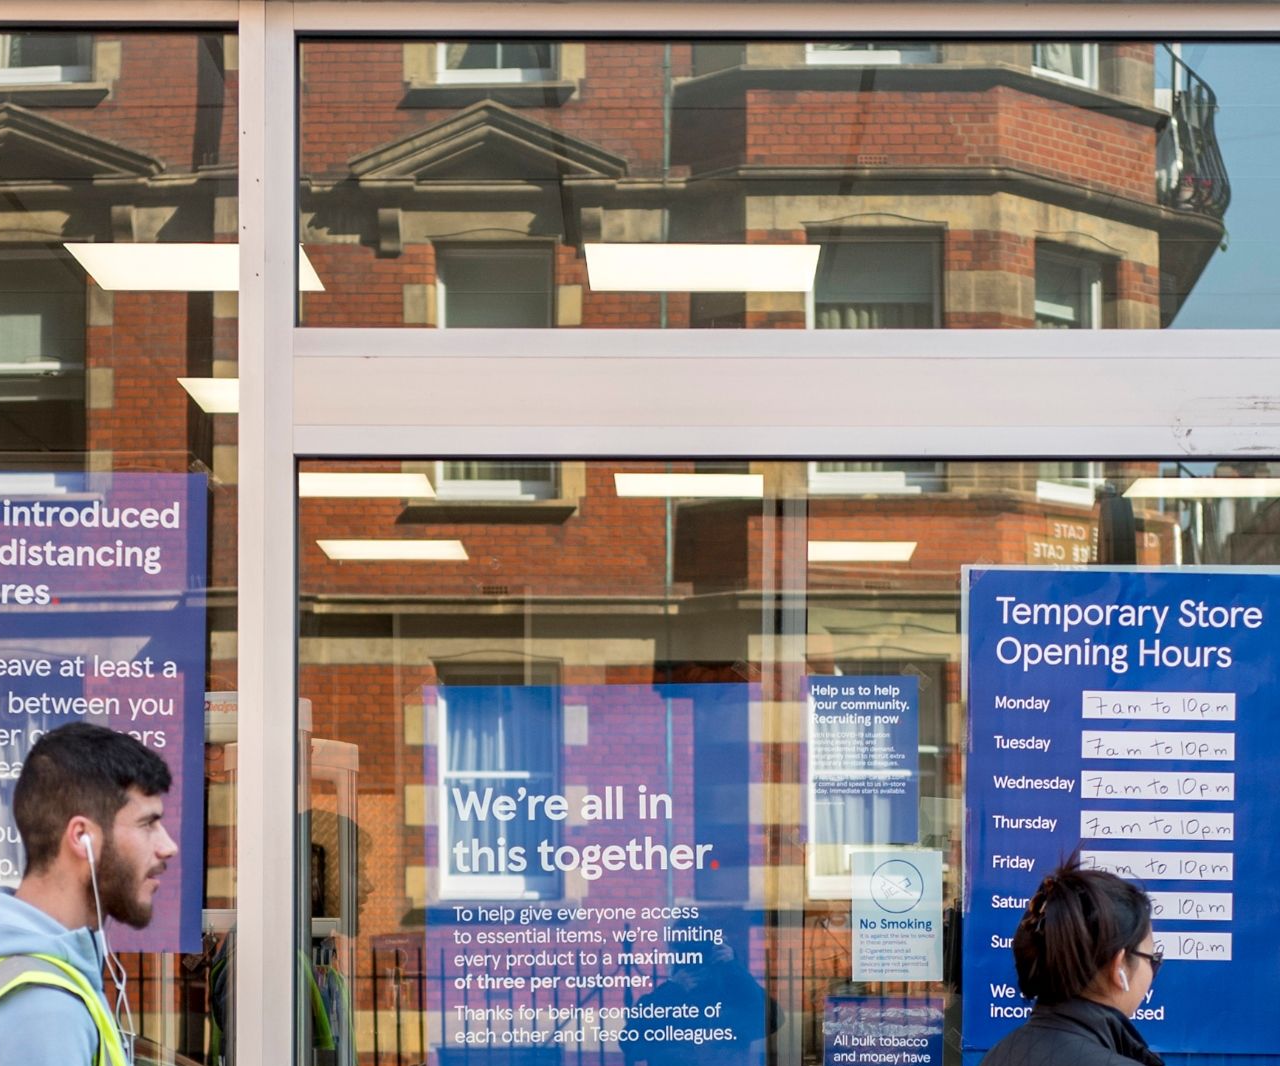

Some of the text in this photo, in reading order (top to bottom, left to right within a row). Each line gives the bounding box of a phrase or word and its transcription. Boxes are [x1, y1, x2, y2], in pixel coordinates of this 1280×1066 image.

[3, 499, 180, 528] introduced
[996, 597, 1263, 634] Temporary Store
[996, 637, 1232, 673] Opening Hours
[59, 656, 85, 677] at
[93, 655, 154, 678] least
[162, 660, 177, 678] a
[811, 685, 900, 698] Help us to help
[8, 692, 120, 715] between
[128, 698, 173, 720] you
[811, 699, 910, 713] your community.
[995, 696, 1050, 713] Monday
[1150, 697, 1170, 714] to
[811, 713, 871, 727] Recruiting
[994, 736, 1051, 753] Tuesday
[1150, 738, 1172, 756] to
[993, 775, 1075, 793] Wednesday
[1147, 778, 1169, 795] to
[452, 785, 673, 821] We're all in
[993, 815, 1057, 832] Thursday
[1149, 816, 1173, 834] to
[452, 836, 719, 880] this together.
[992, 856, 1035, 871] Friday
[1145, 857, 1167, 875] to
[991, 895, 1031, 909] Satur
[453, 905, 699, 924] To help give everyone access
[860, 918, 932, 932] No Smoking
[453, 926, 723, 944] to essential items, we're limiting
[454, 949, 703, 970] every product to a maximum
[454, 974, 653, 992] of three per customer.
[990, 983, 1015, 998] We
[454, 1002, 722, 1023] Thanks for being considerate of
[454, 1025, 737, 1044] each other and Tesco colleagues.
[834, 1035, 928, 1047] All bulk tobacco
[833, 1052, 931, 1065] and money have
